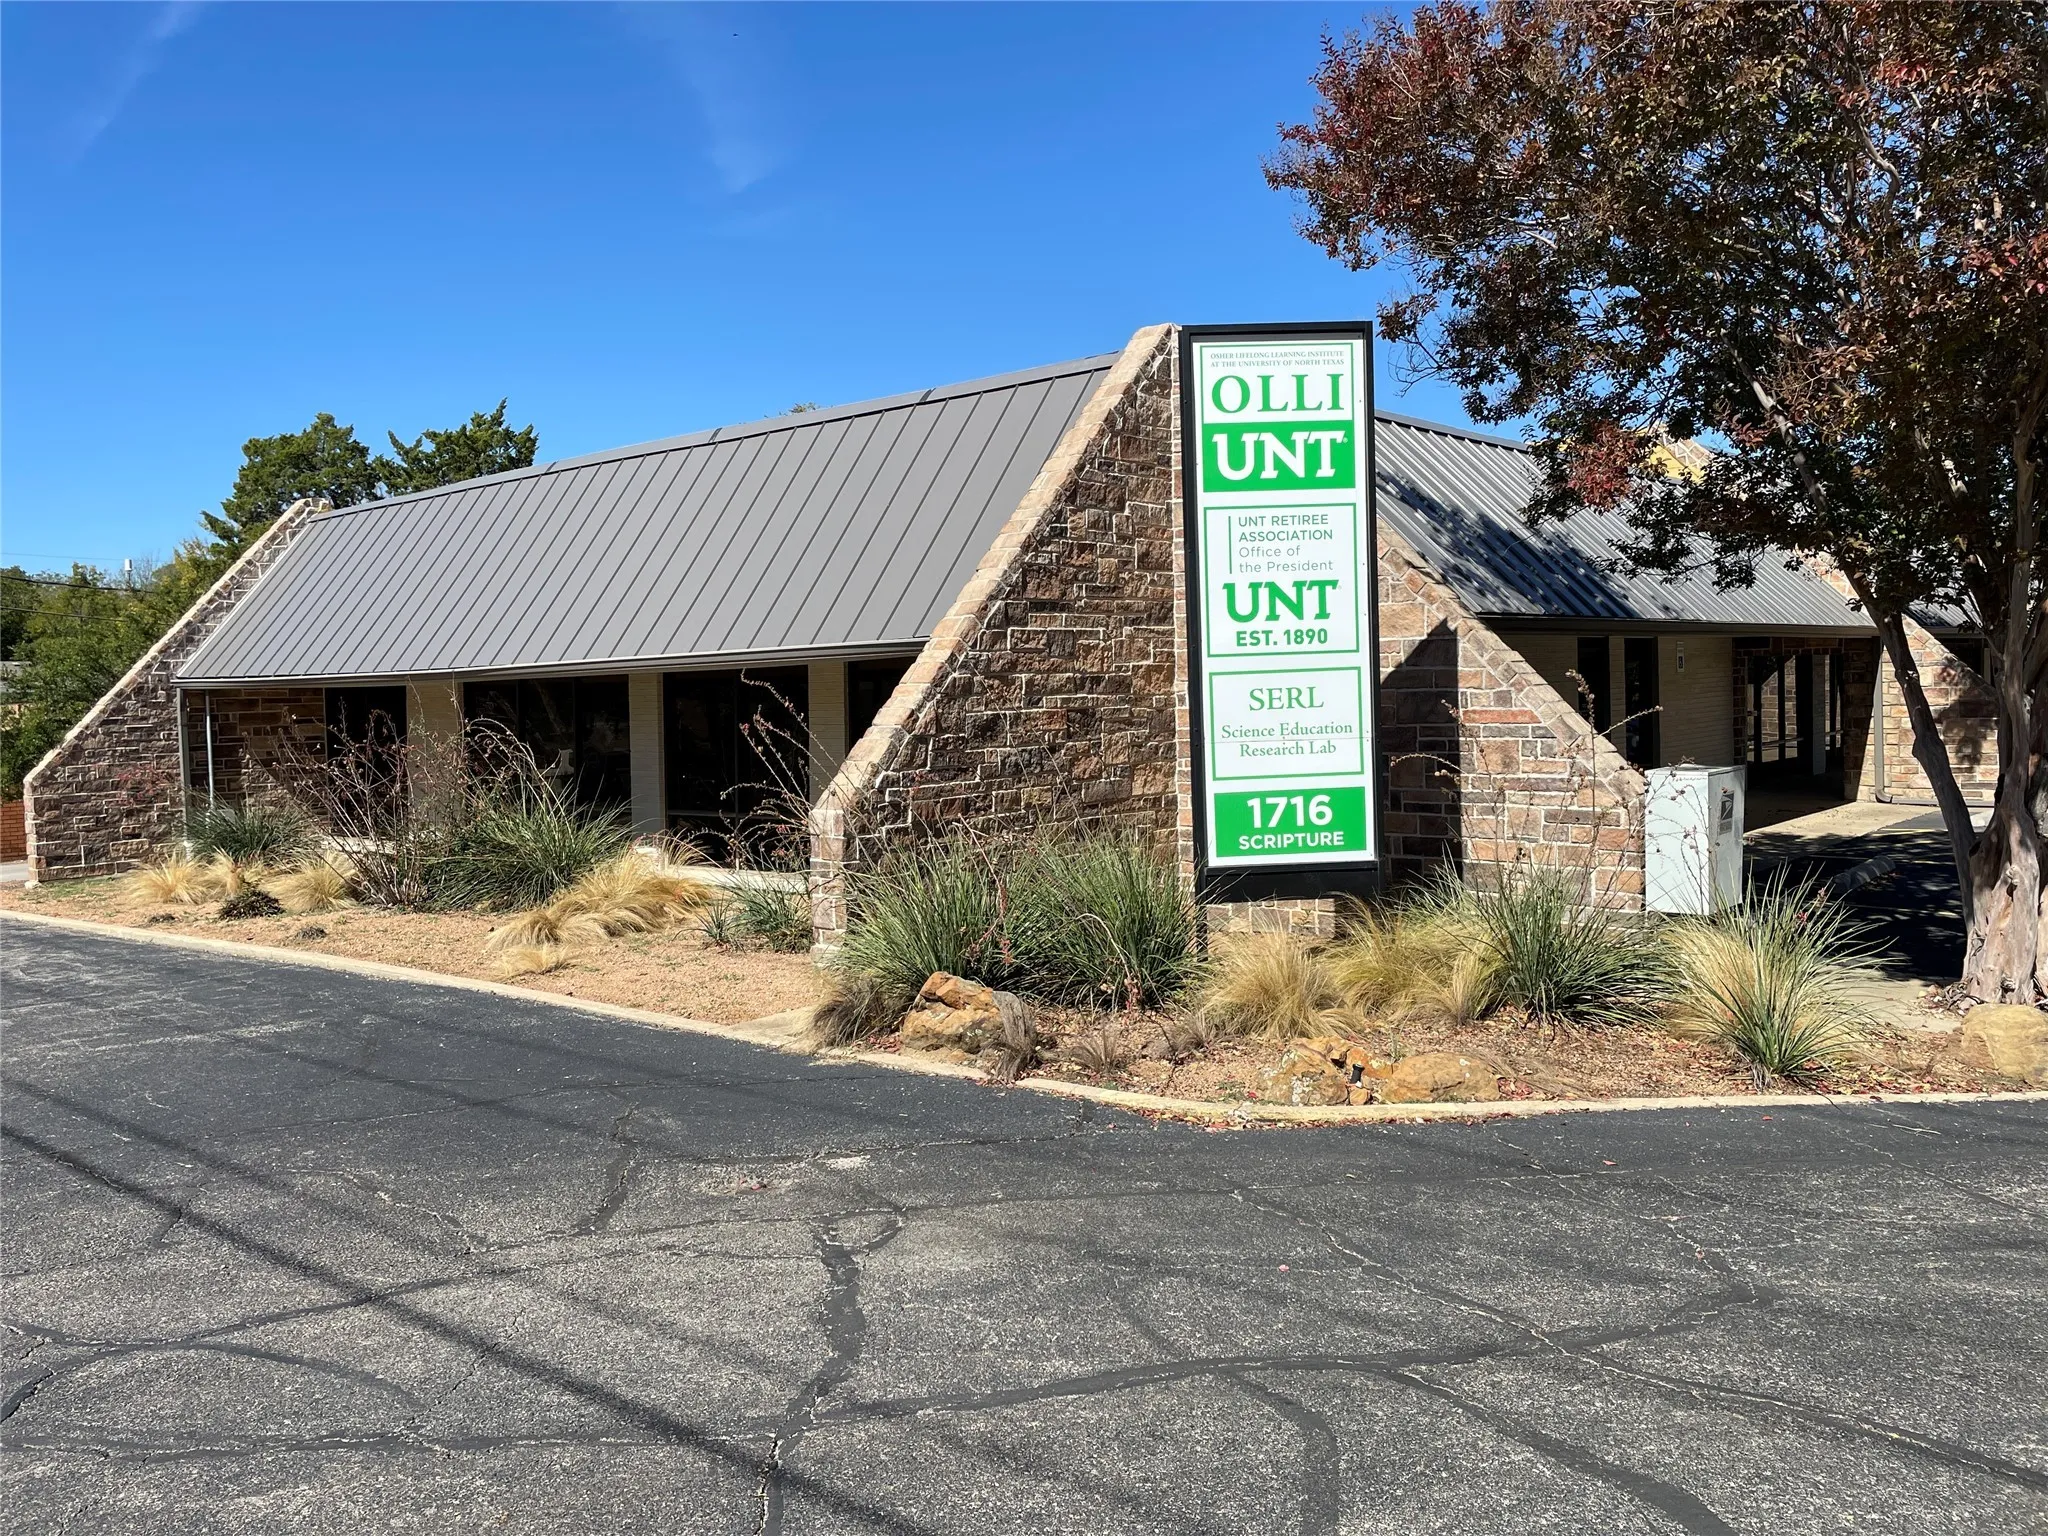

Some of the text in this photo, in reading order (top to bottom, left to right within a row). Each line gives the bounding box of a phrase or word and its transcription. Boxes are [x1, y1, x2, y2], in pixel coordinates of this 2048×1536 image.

[1211, 373, 1345, 414] OLLI
[1211, 430, 1346, 481] UNT
[1238, 514, 1329, 527] UNT RETIREE
[1238, 529, 1333, 543] ASSOCIATION
[1239, 545, 1301, 558] Office of
[1239, 560, 1334, 573] the President
[1222, 579, 1340, 623] UNT
[1236, 628, 1328, 647] EST. 1890
[1249, 686, 1324, 711] SERL
[1221, 721, 1353, 739] Science Education
[1240, 740, 1337, 757] Research Lab
[1246, 794, 1333, 829] 1716
[1238, 831, 1345, 850] SCRIPTURE
